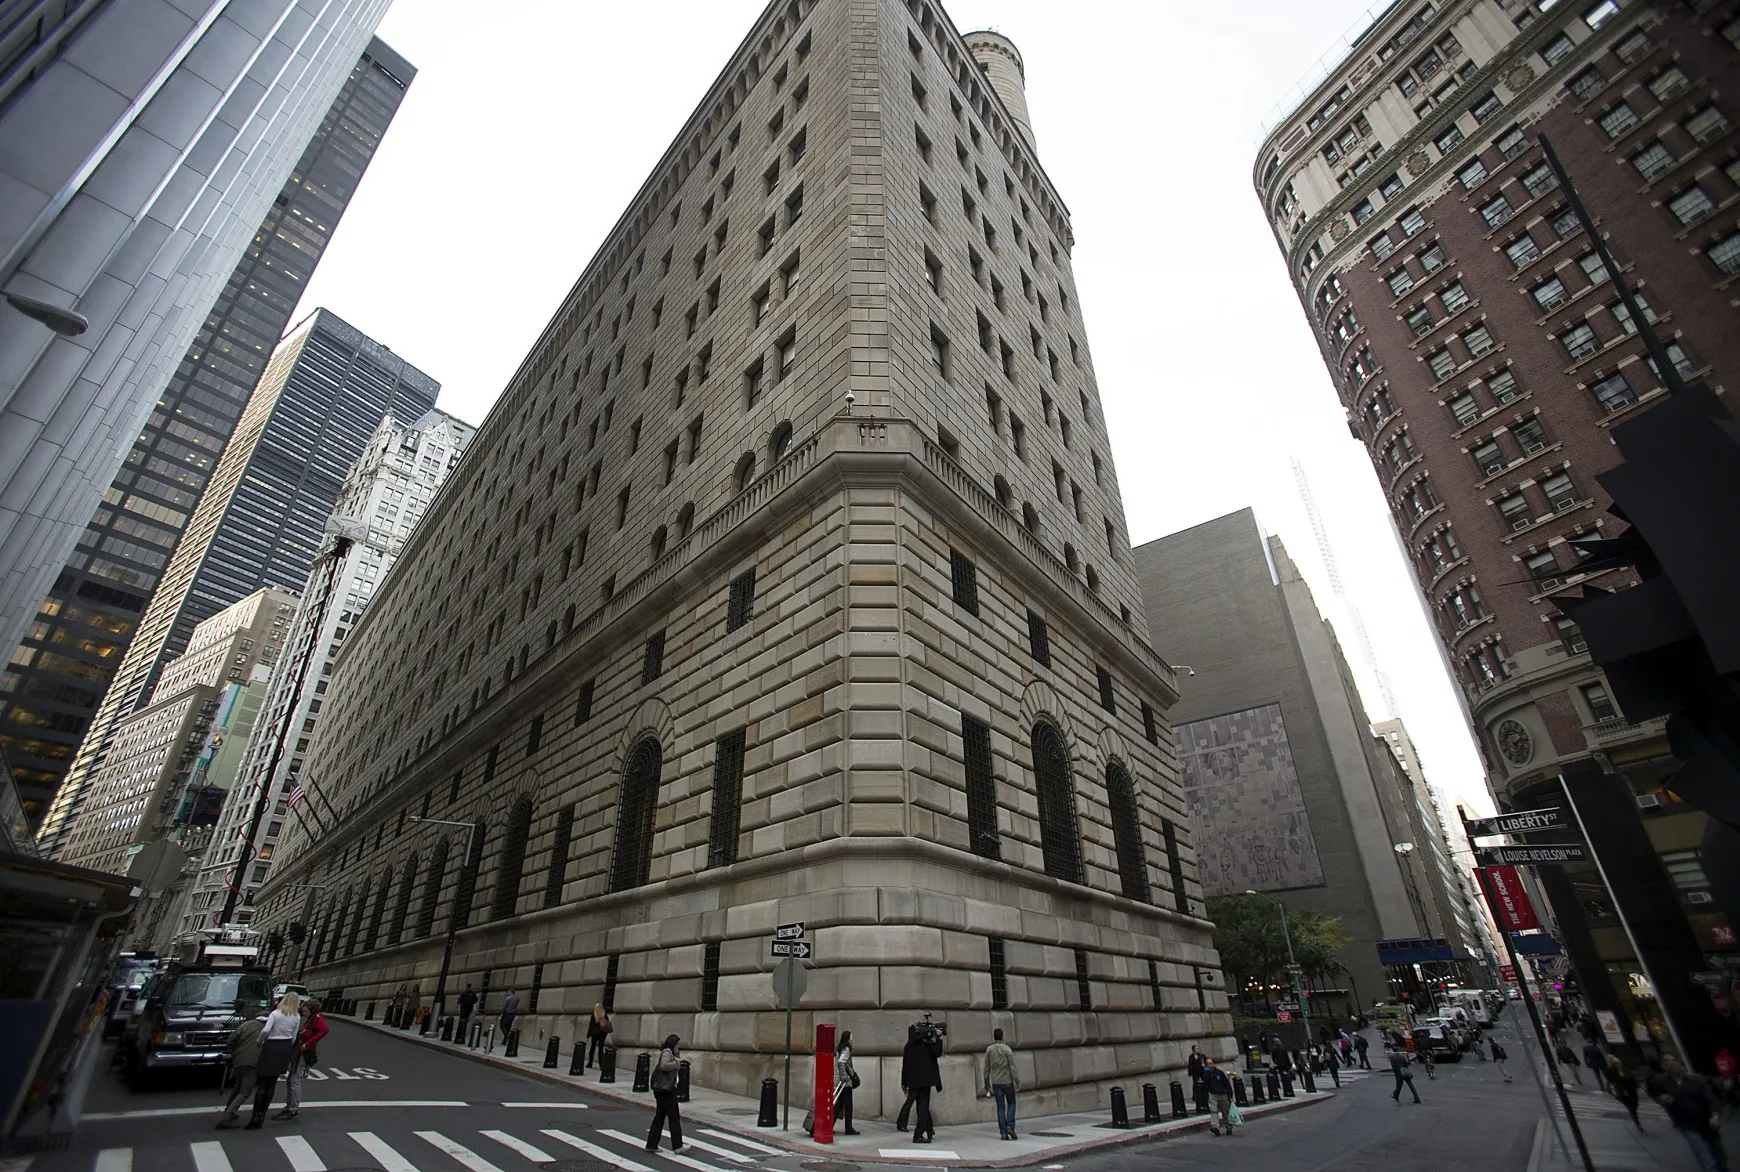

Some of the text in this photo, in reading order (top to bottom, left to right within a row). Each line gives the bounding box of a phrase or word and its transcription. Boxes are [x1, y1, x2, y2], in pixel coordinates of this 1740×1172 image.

[1500, 814, 1550, 831] LIBERTY
[1503, 850, 1530, 861] LOUISE
[1529, 850, 1568, 861] NEVELSON
[1492, 870, 1520, 925] THE NEW SCHOOL
[780, 929, 789, 937] ONE
[776, 945, 789, 953] ONE
